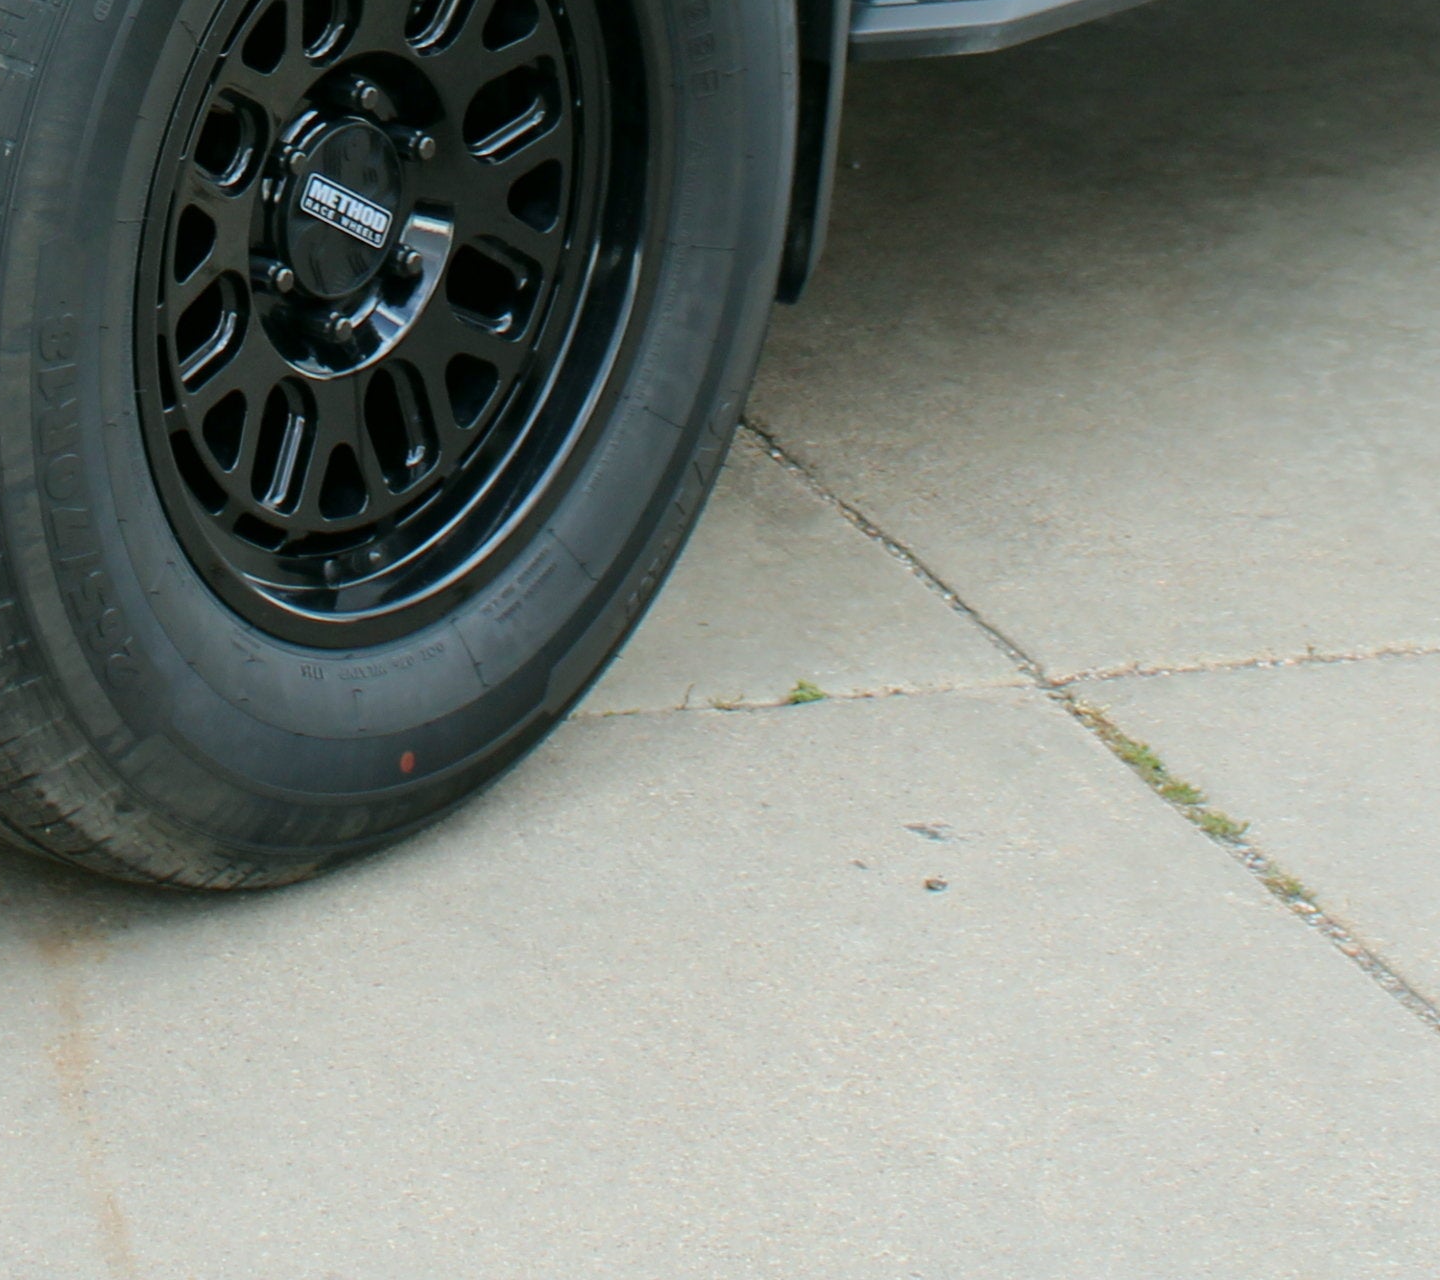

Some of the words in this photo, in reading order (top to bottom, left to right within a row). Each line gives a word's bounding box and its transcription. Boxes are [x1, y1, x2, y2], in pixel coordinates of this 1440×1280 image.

[304, 198, 334, 220] RACE
[341, 217, 382, 243] WHEELS
[309, 180, 388, 232] METHOD
